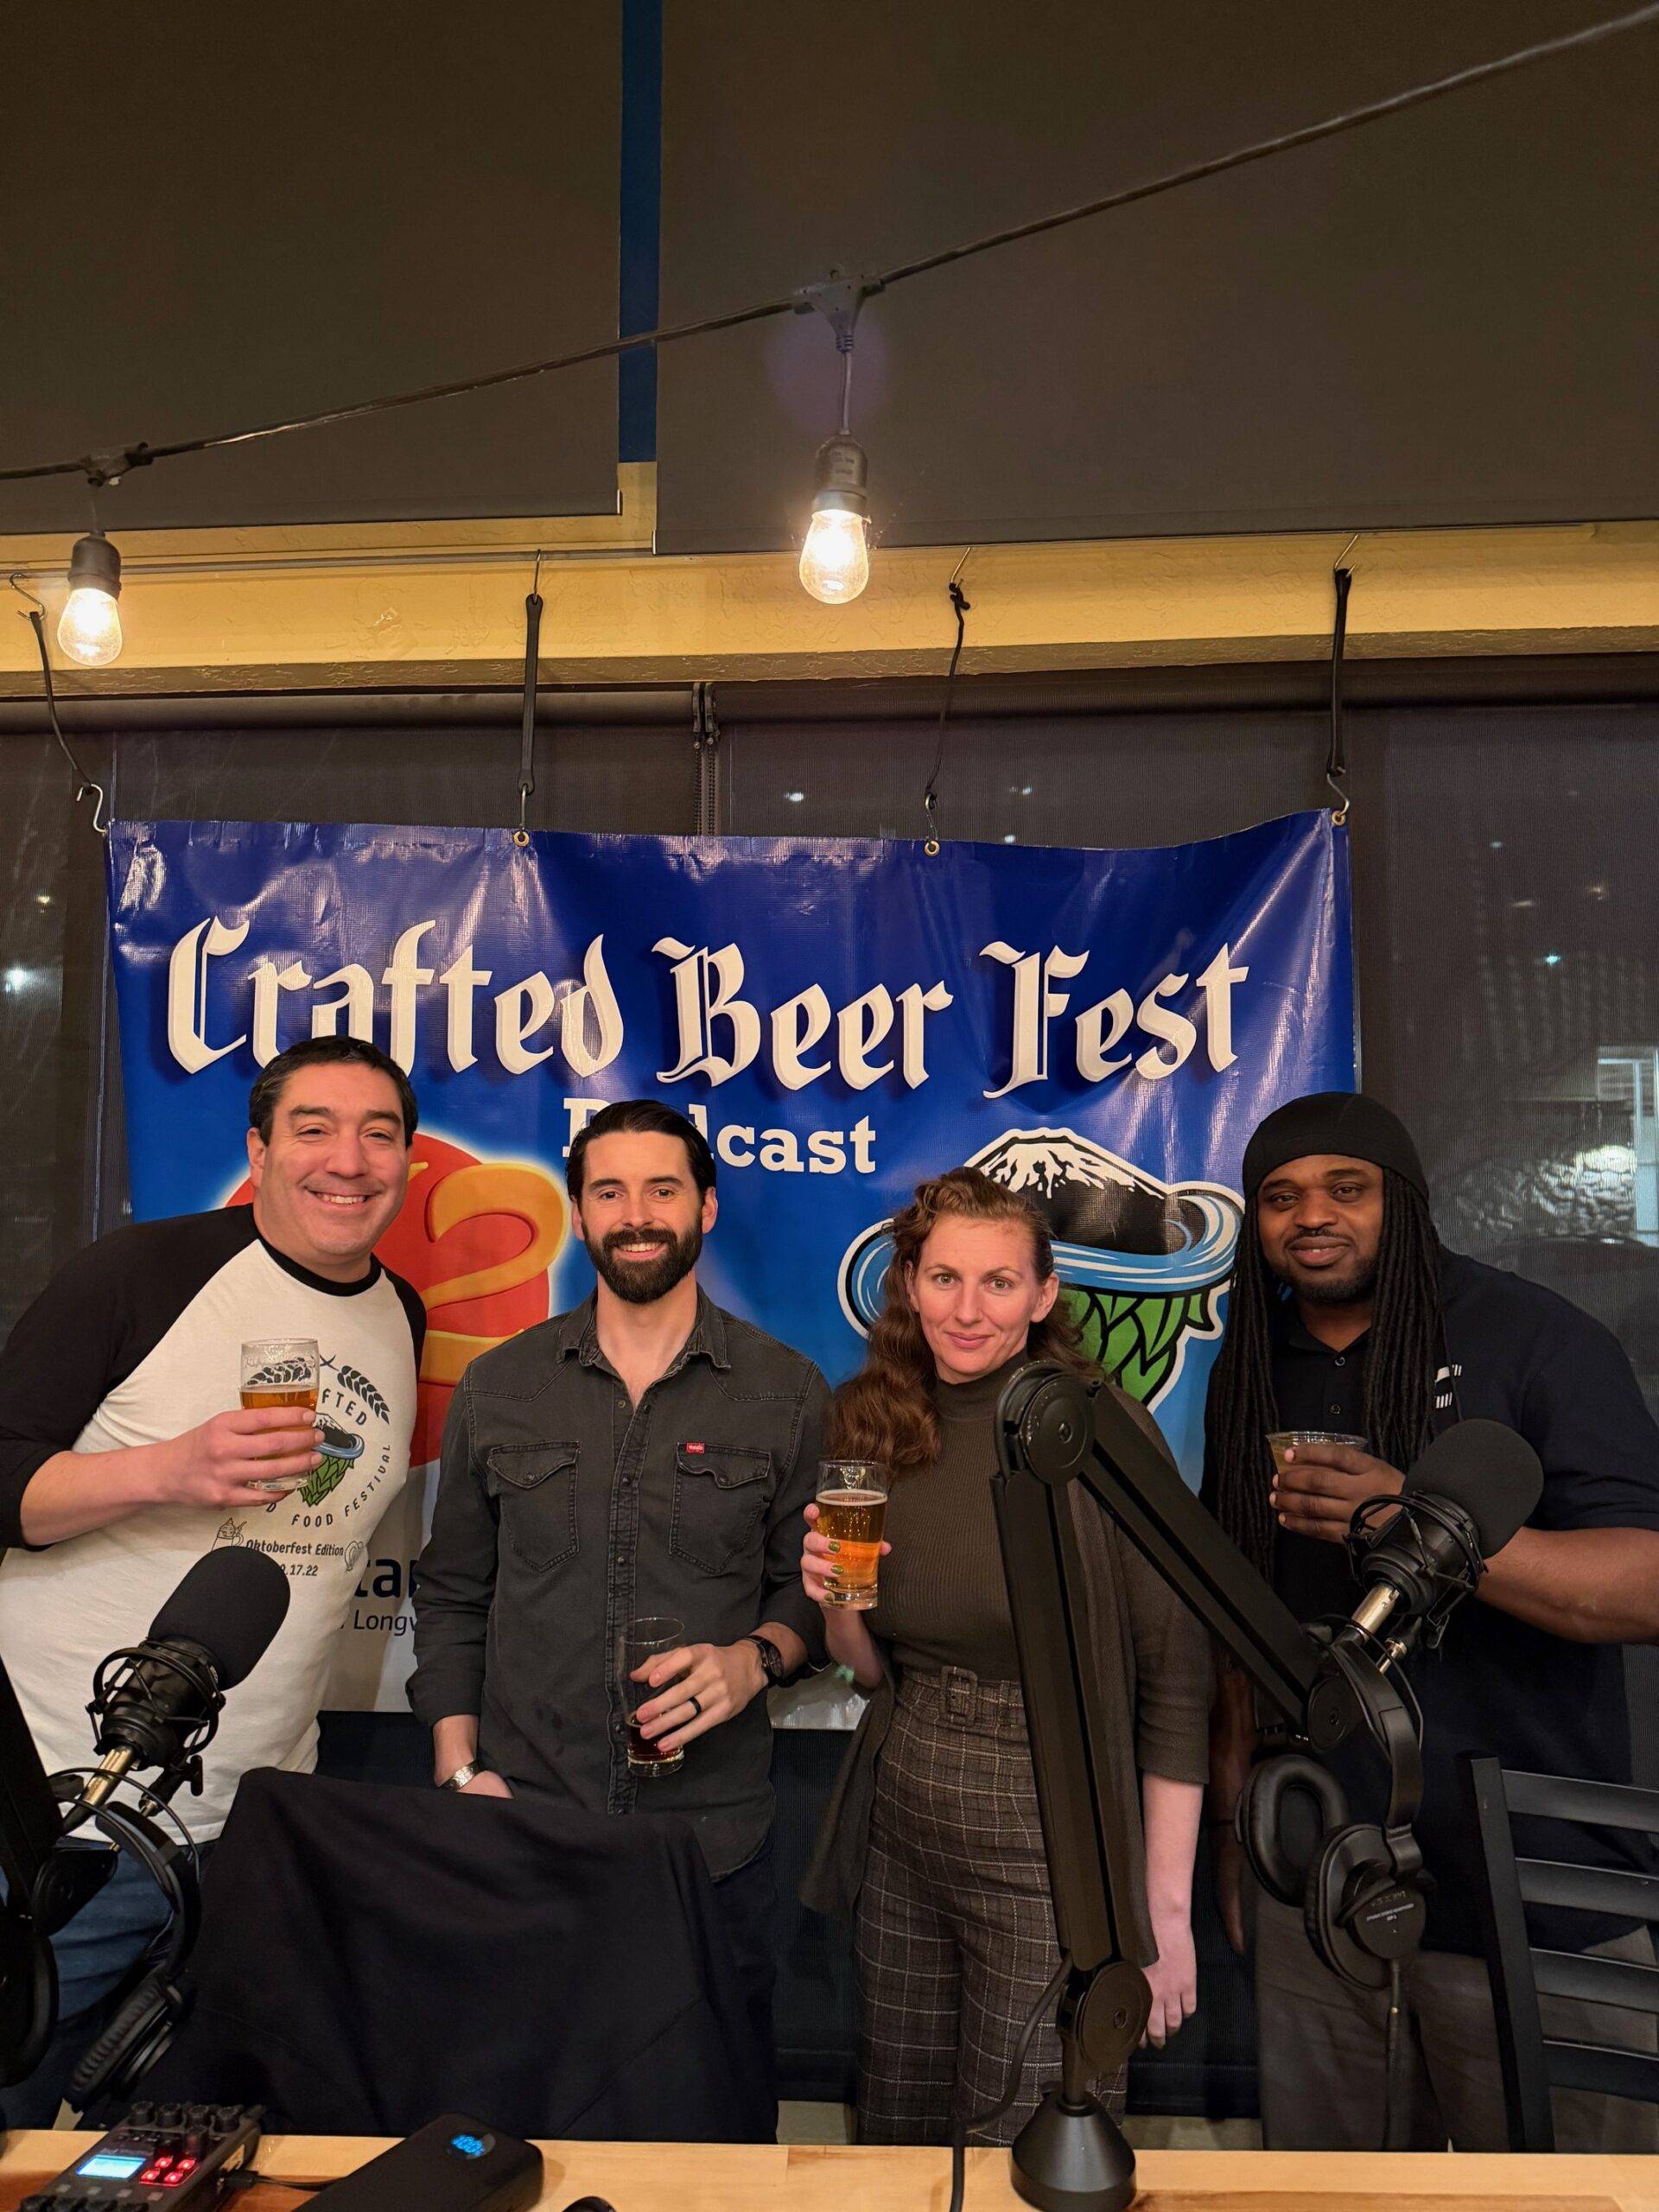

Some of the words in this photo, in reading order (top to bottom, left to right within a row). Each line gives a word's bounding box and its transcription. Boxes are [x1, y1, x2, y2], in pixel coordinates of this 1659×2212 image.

[168, 915, 624, 1077] Crafted
[652, 937, 953, 1090] Beer
[979, 940, 1249, 1099] Fest
[321, 1388, 367, 1426] FTED
[291, 1513, 334, 1528] FOOD
[345, 1444, 391, 1517] FESTIVAL
[246, 1539, 312, 1555] Oktoberfest
[315, 1543, 344, 1556] Edition
